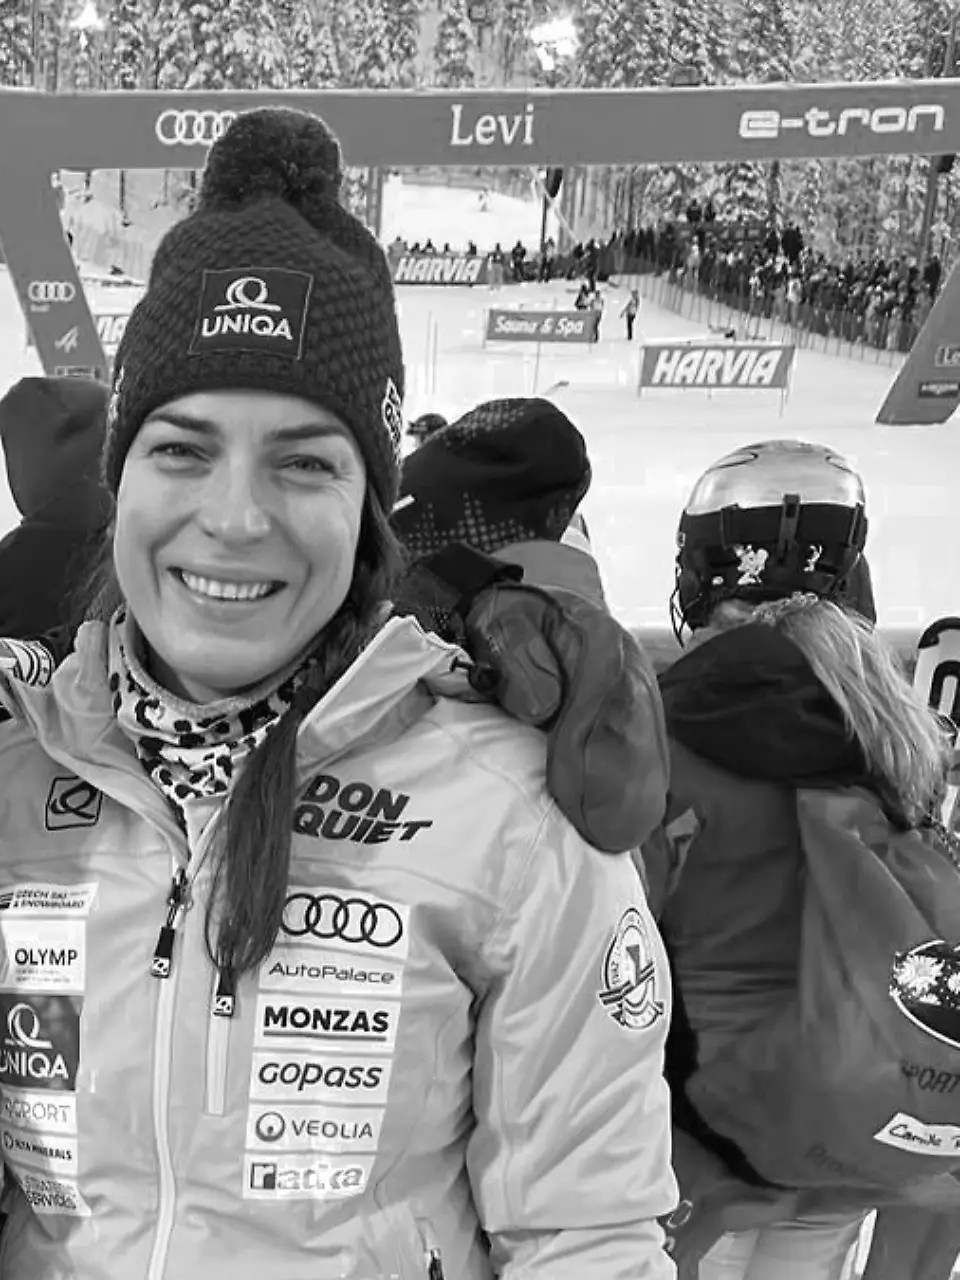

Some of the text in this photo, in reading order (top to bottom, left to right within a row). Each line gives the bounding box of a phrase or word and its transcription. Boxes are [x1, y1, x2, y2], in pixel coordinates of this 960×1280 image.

[450, 103, 534, 146] Levi
[740, 104, 944, 139] e-tron
[395, 257, 483, 282] HARVIA
[201, 313, 293, 340] UNIQA
[494, 315, 585, 338] Sauna & Spa
[651, 349, 783, 385] HARVIA
[300, 774, 411, 822] DON
[293, 803, 434, 845] QUIET
[14, 948, 78, 966] OLYMP
[268, 961, 396, 985] AutoPalace
[263, 1005, 390, 1033] MONZAS
[291, 1119, 373, 1139] VEOLIA
